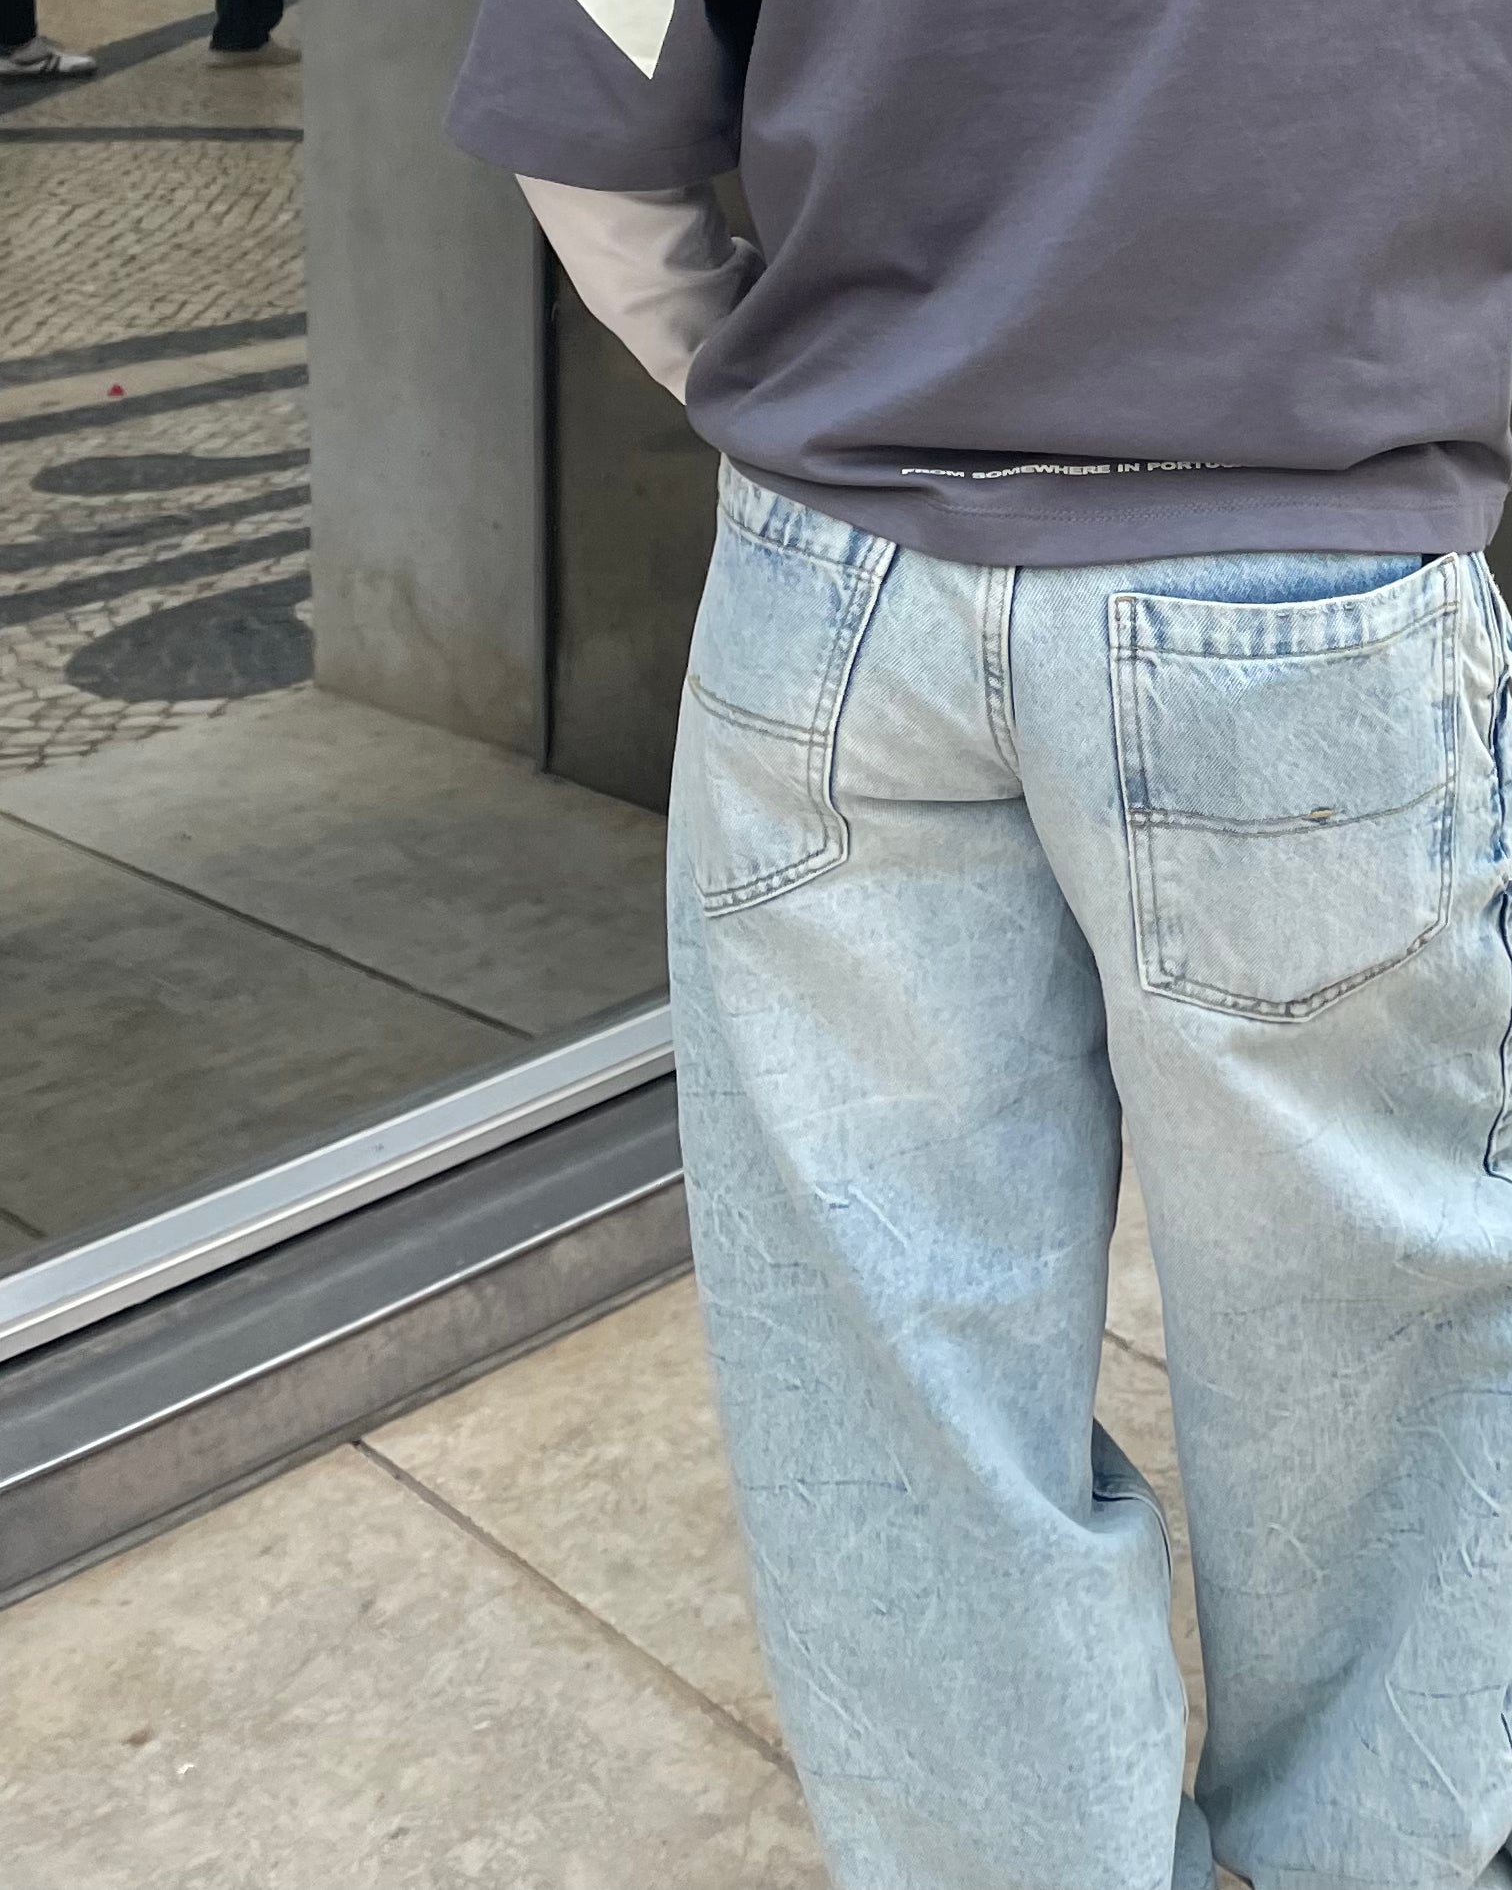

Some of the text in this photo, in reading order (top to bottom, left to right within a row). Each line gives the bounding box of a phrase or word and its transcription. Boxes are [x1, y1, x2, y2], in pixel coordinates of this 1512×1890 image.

[901, 468, 965, 478] FROM
[972, 464, 1111, 479] SOMEWHERE
[1117, 463, 1139, 473] IN
